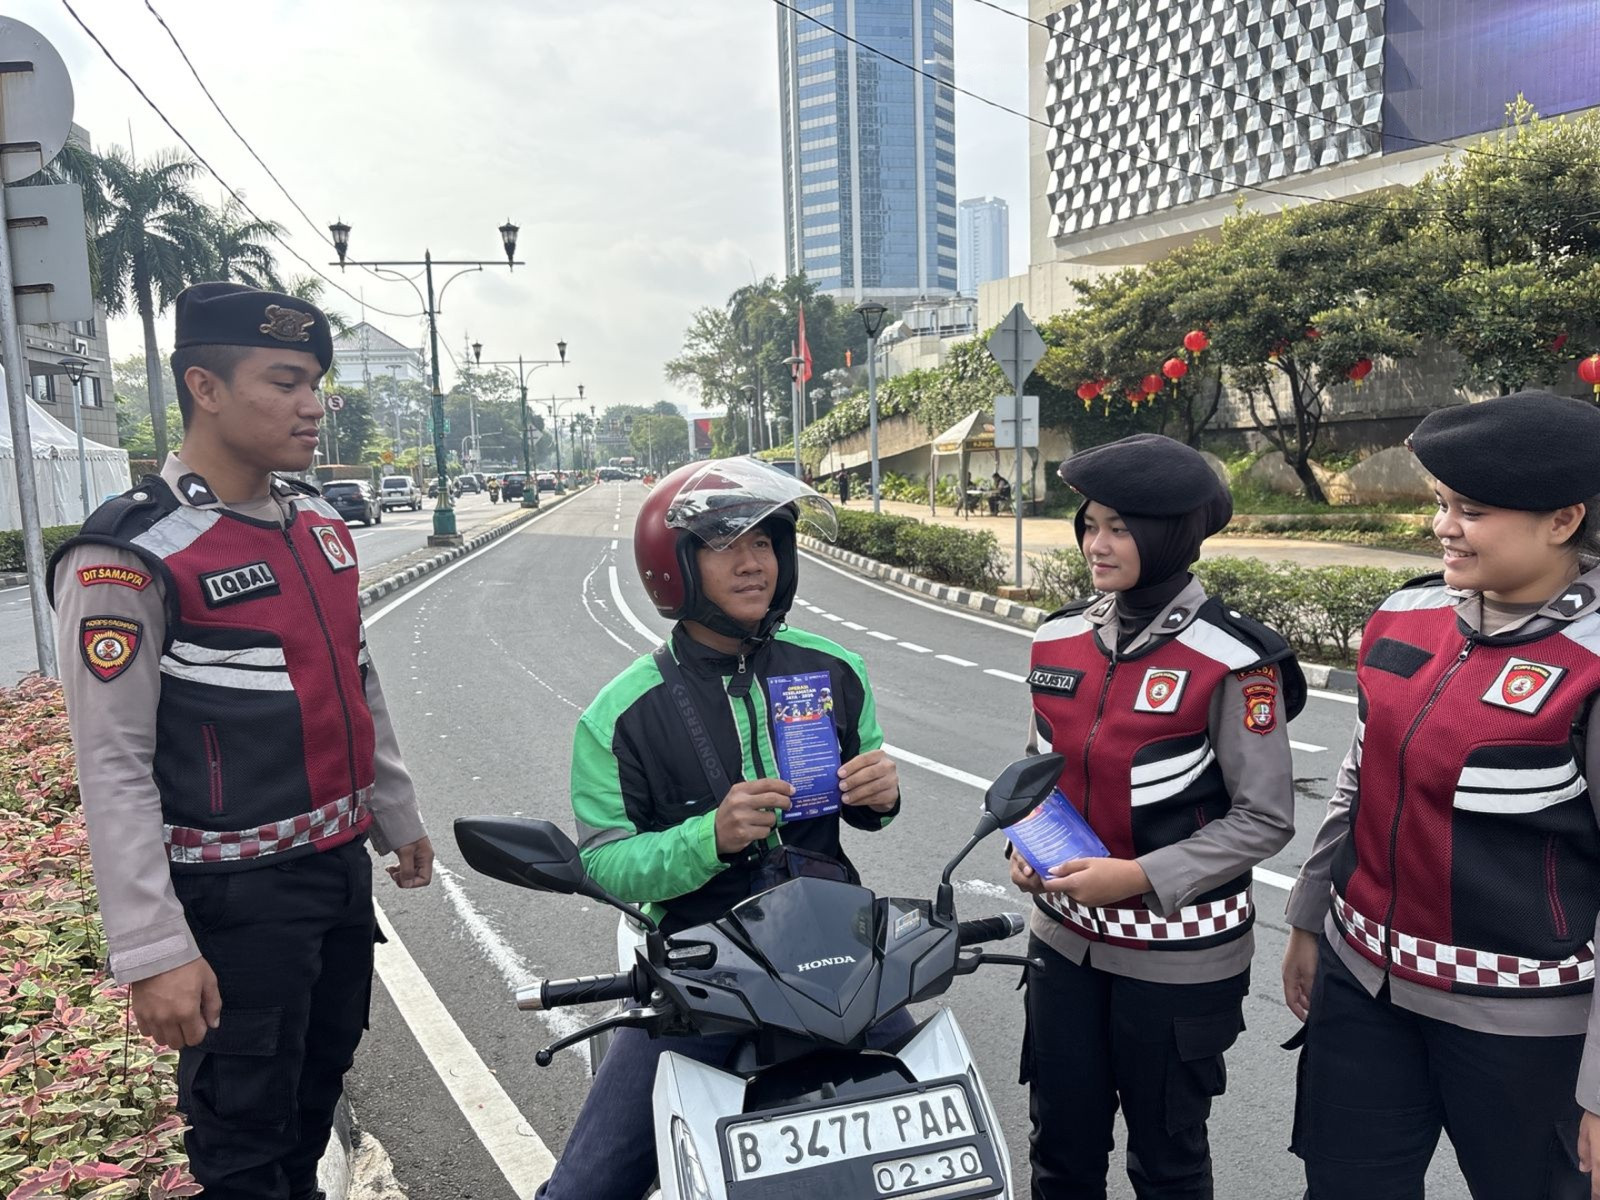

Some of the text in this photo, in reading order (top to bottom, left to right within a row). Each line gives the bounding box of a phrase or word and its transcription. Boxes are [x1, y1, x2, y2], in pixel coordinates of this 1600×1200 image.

[82, 568, 143, 586] DIT SAMAPTA
[211, 565, 273, 597] IQBAL
[679, 698, 721, 780] CONVERSE
[797, 955, 857, 973] HONDA
[738, 1096, 967, 1174] B 3477 PAA
